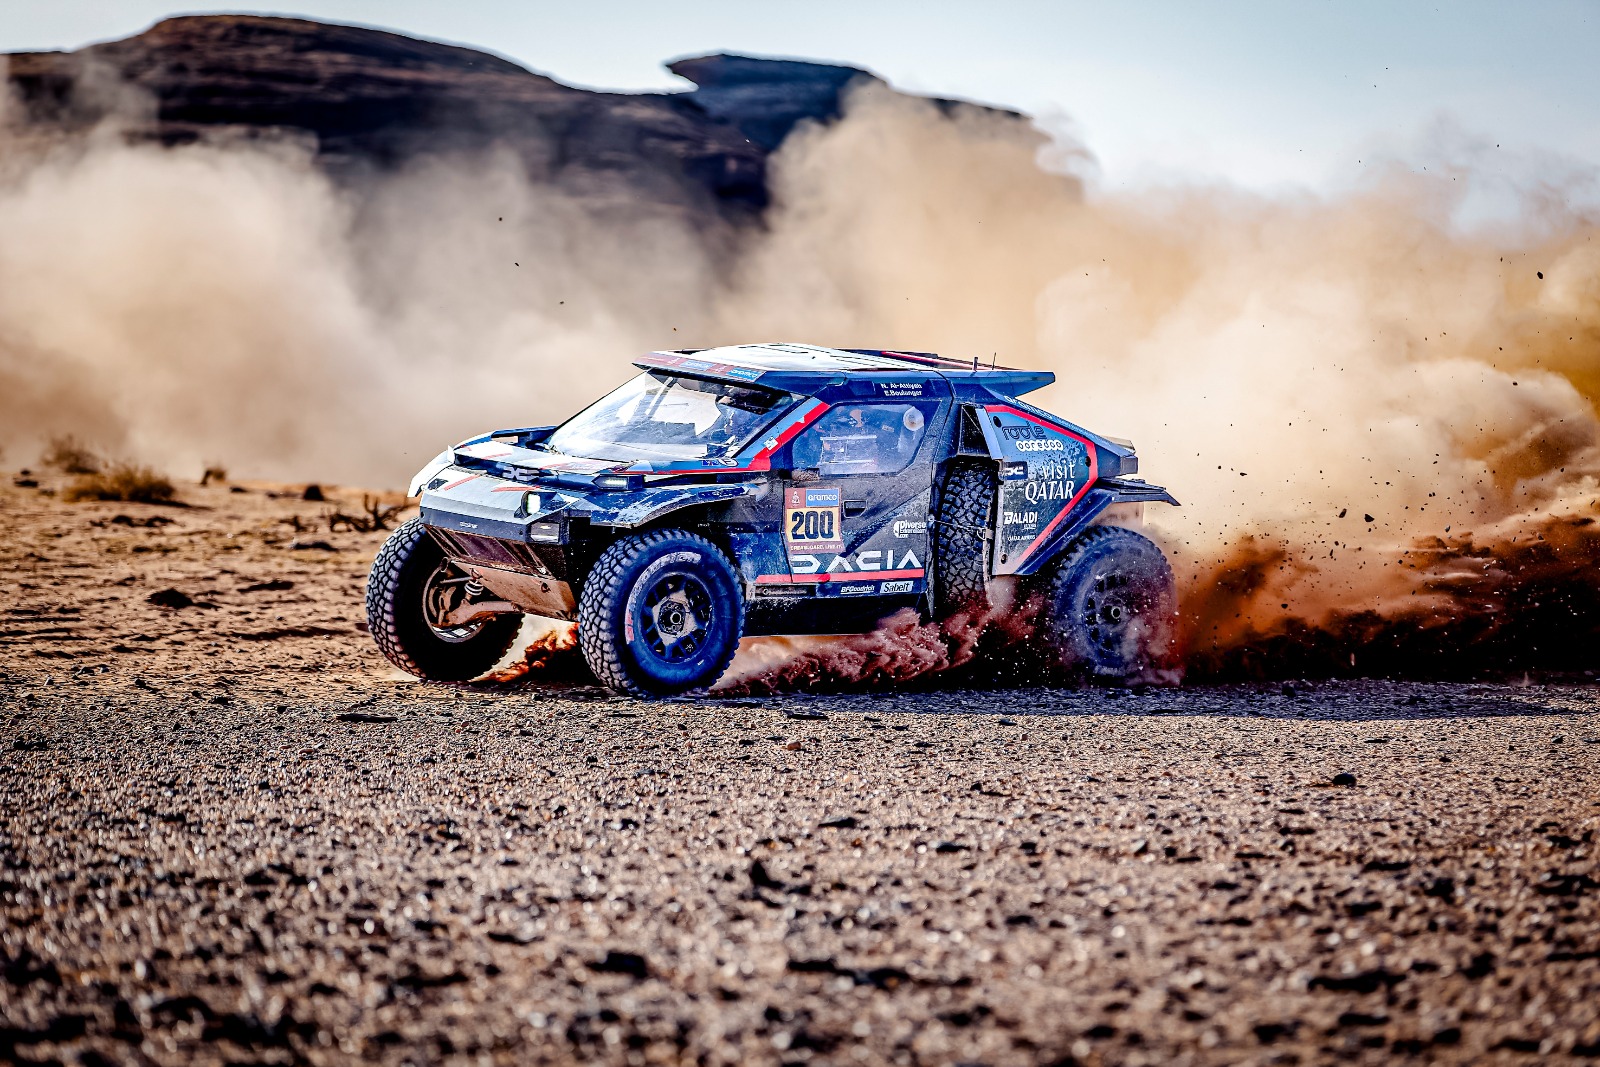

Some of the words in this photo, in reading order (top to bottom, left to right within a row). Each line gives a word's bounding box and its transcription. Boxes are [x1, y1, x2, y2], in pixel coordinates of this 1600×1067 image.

[730, 367, 759, 379] aramco
[1016, 440, 1063, 451] ooredoo
[1042, 460, 1075, 479] visit
[1025, 481, 1075, 504] QATAR
[1003, 511, 1038, 524] BALADI
[791, 511, 834, 539] 200
[900, 520, 927, 529] Diverse
[789, 548, 922, 574] DACIA
[883, 582, 910, 593] Sabelt
